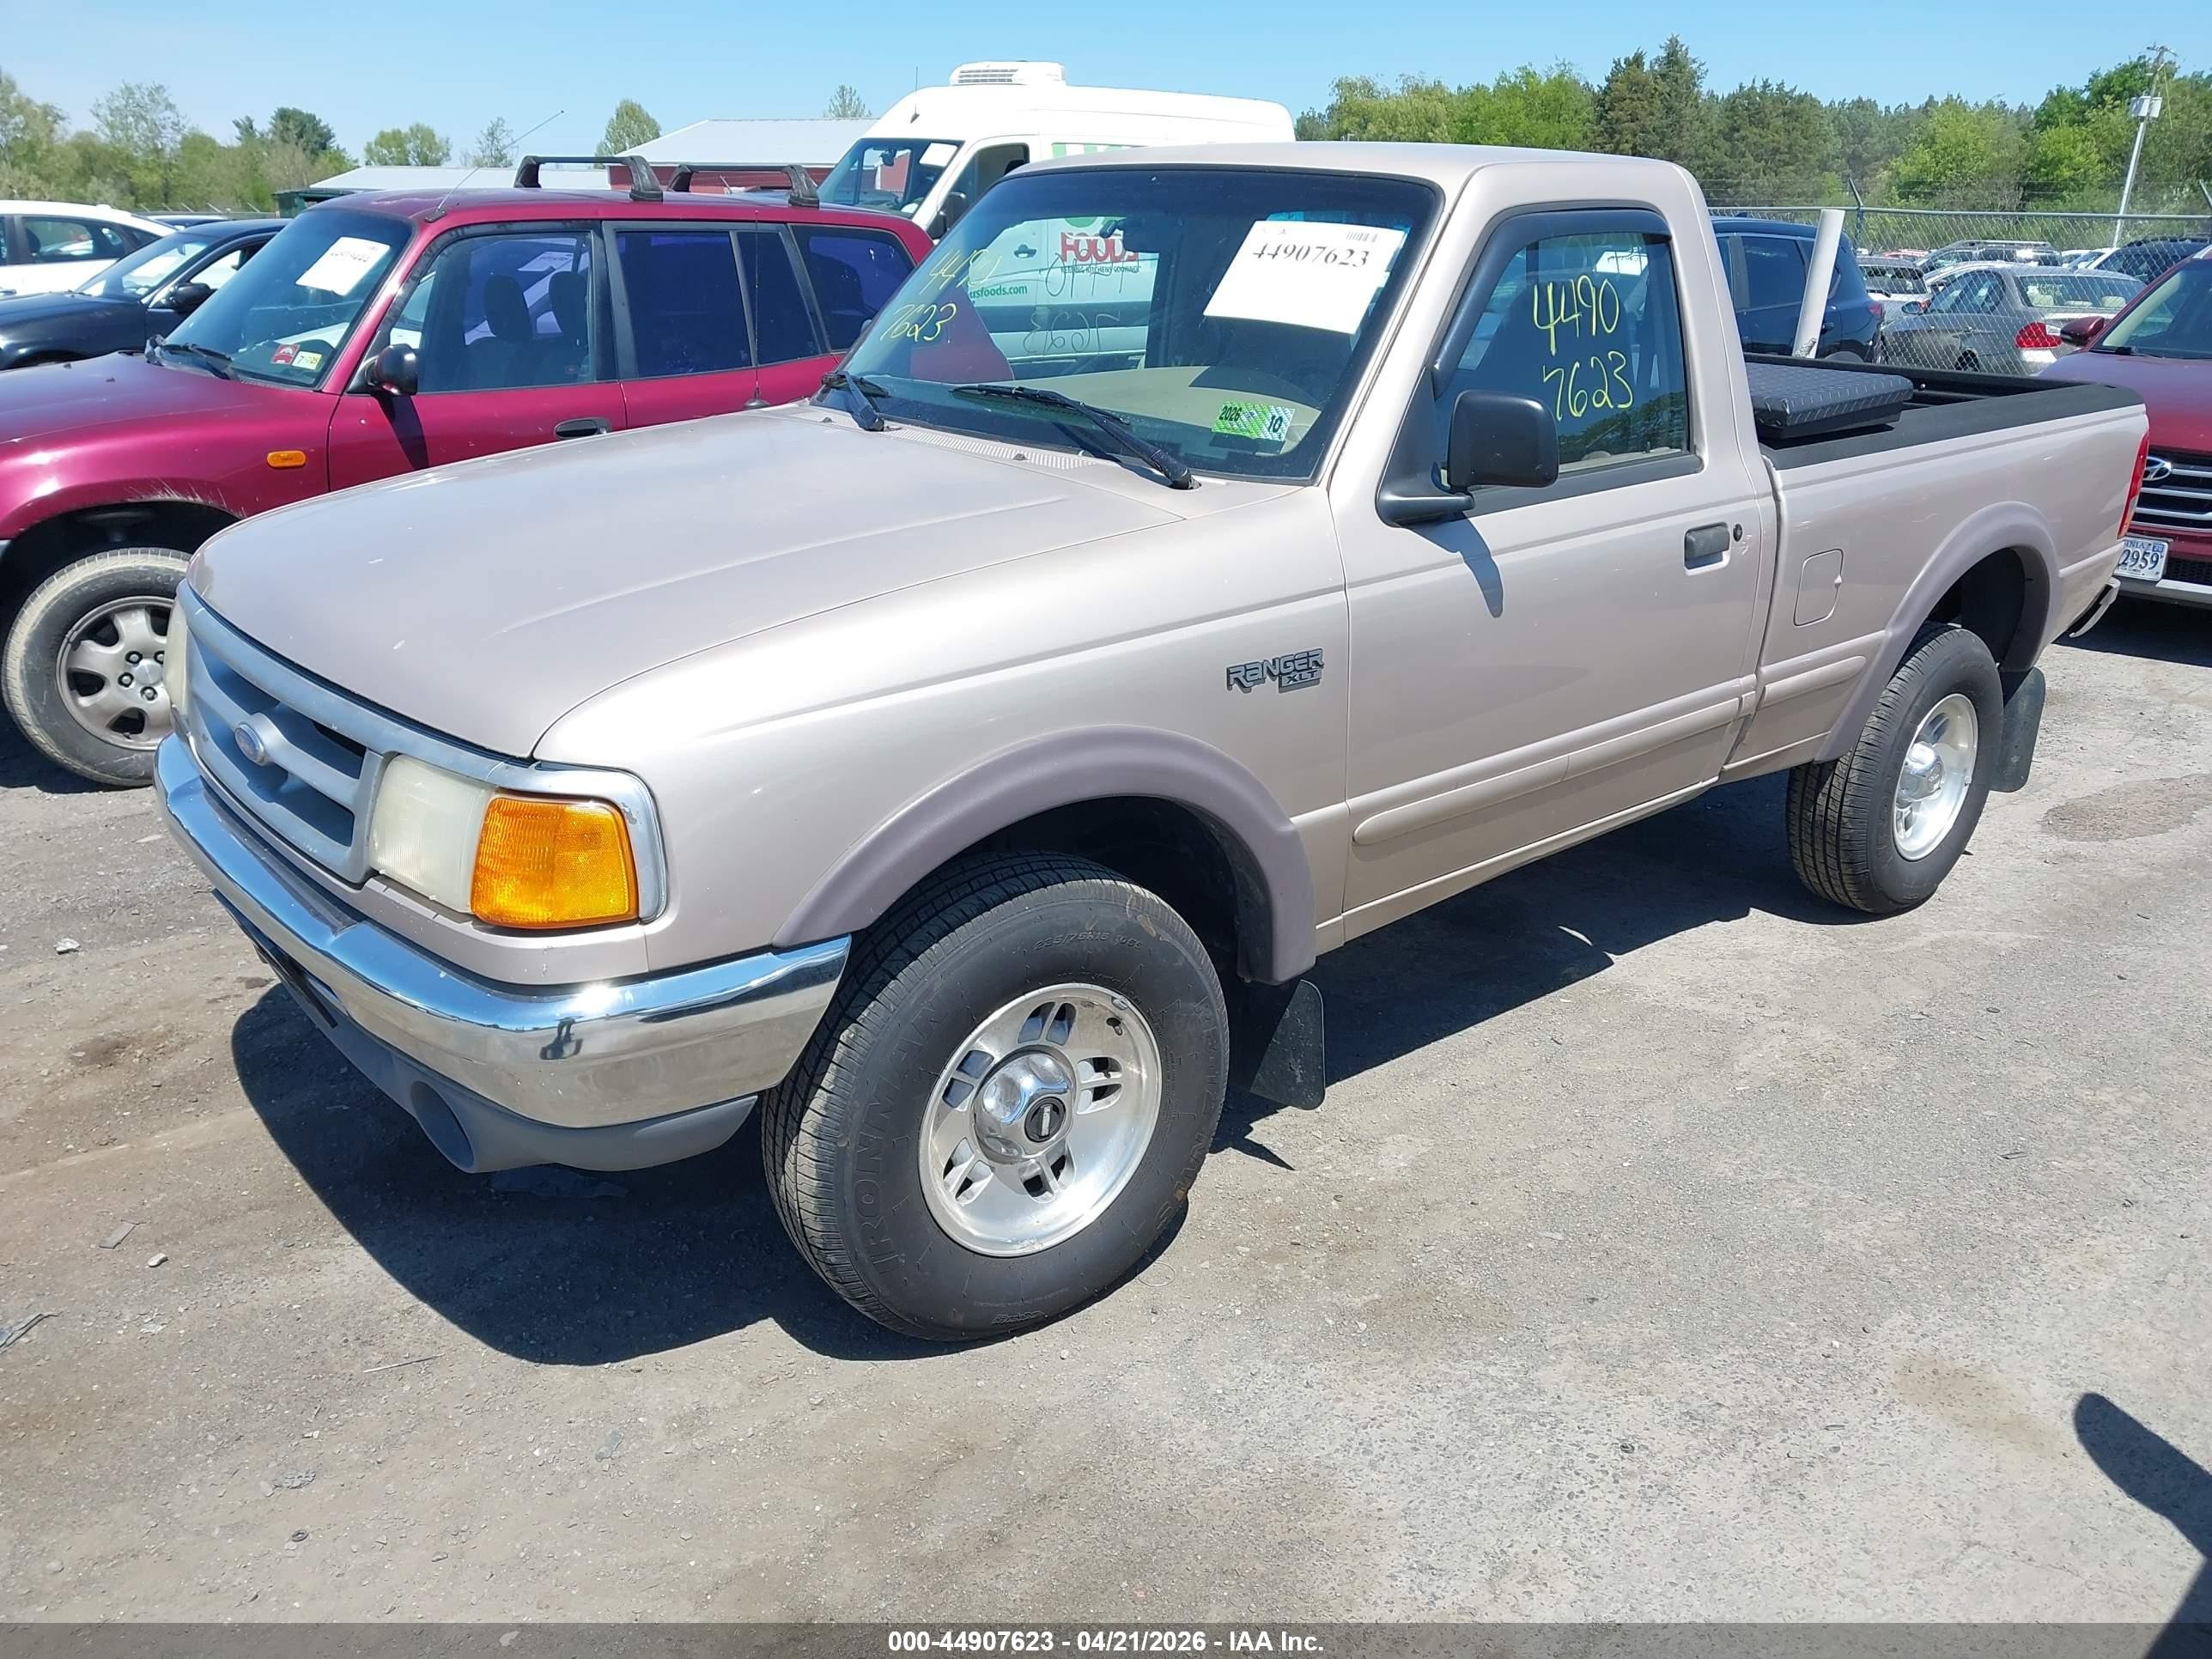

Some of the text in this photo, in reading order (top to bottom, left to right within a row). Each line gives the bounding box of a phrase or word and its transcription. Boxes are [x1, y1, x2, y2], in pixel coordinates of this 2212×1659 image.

[1253, 242, 1370, 268] 44907623
[1534, 275, 1620, 356] 4490
[1542, 350, 1632, 422] 7623
[1268, 415, 1284, 433] 10
[2118, 550, 2160, 570] 2959
[1226, 647, 1324, 694] RANGER
[1279, 668, 1322, 690] XLT
